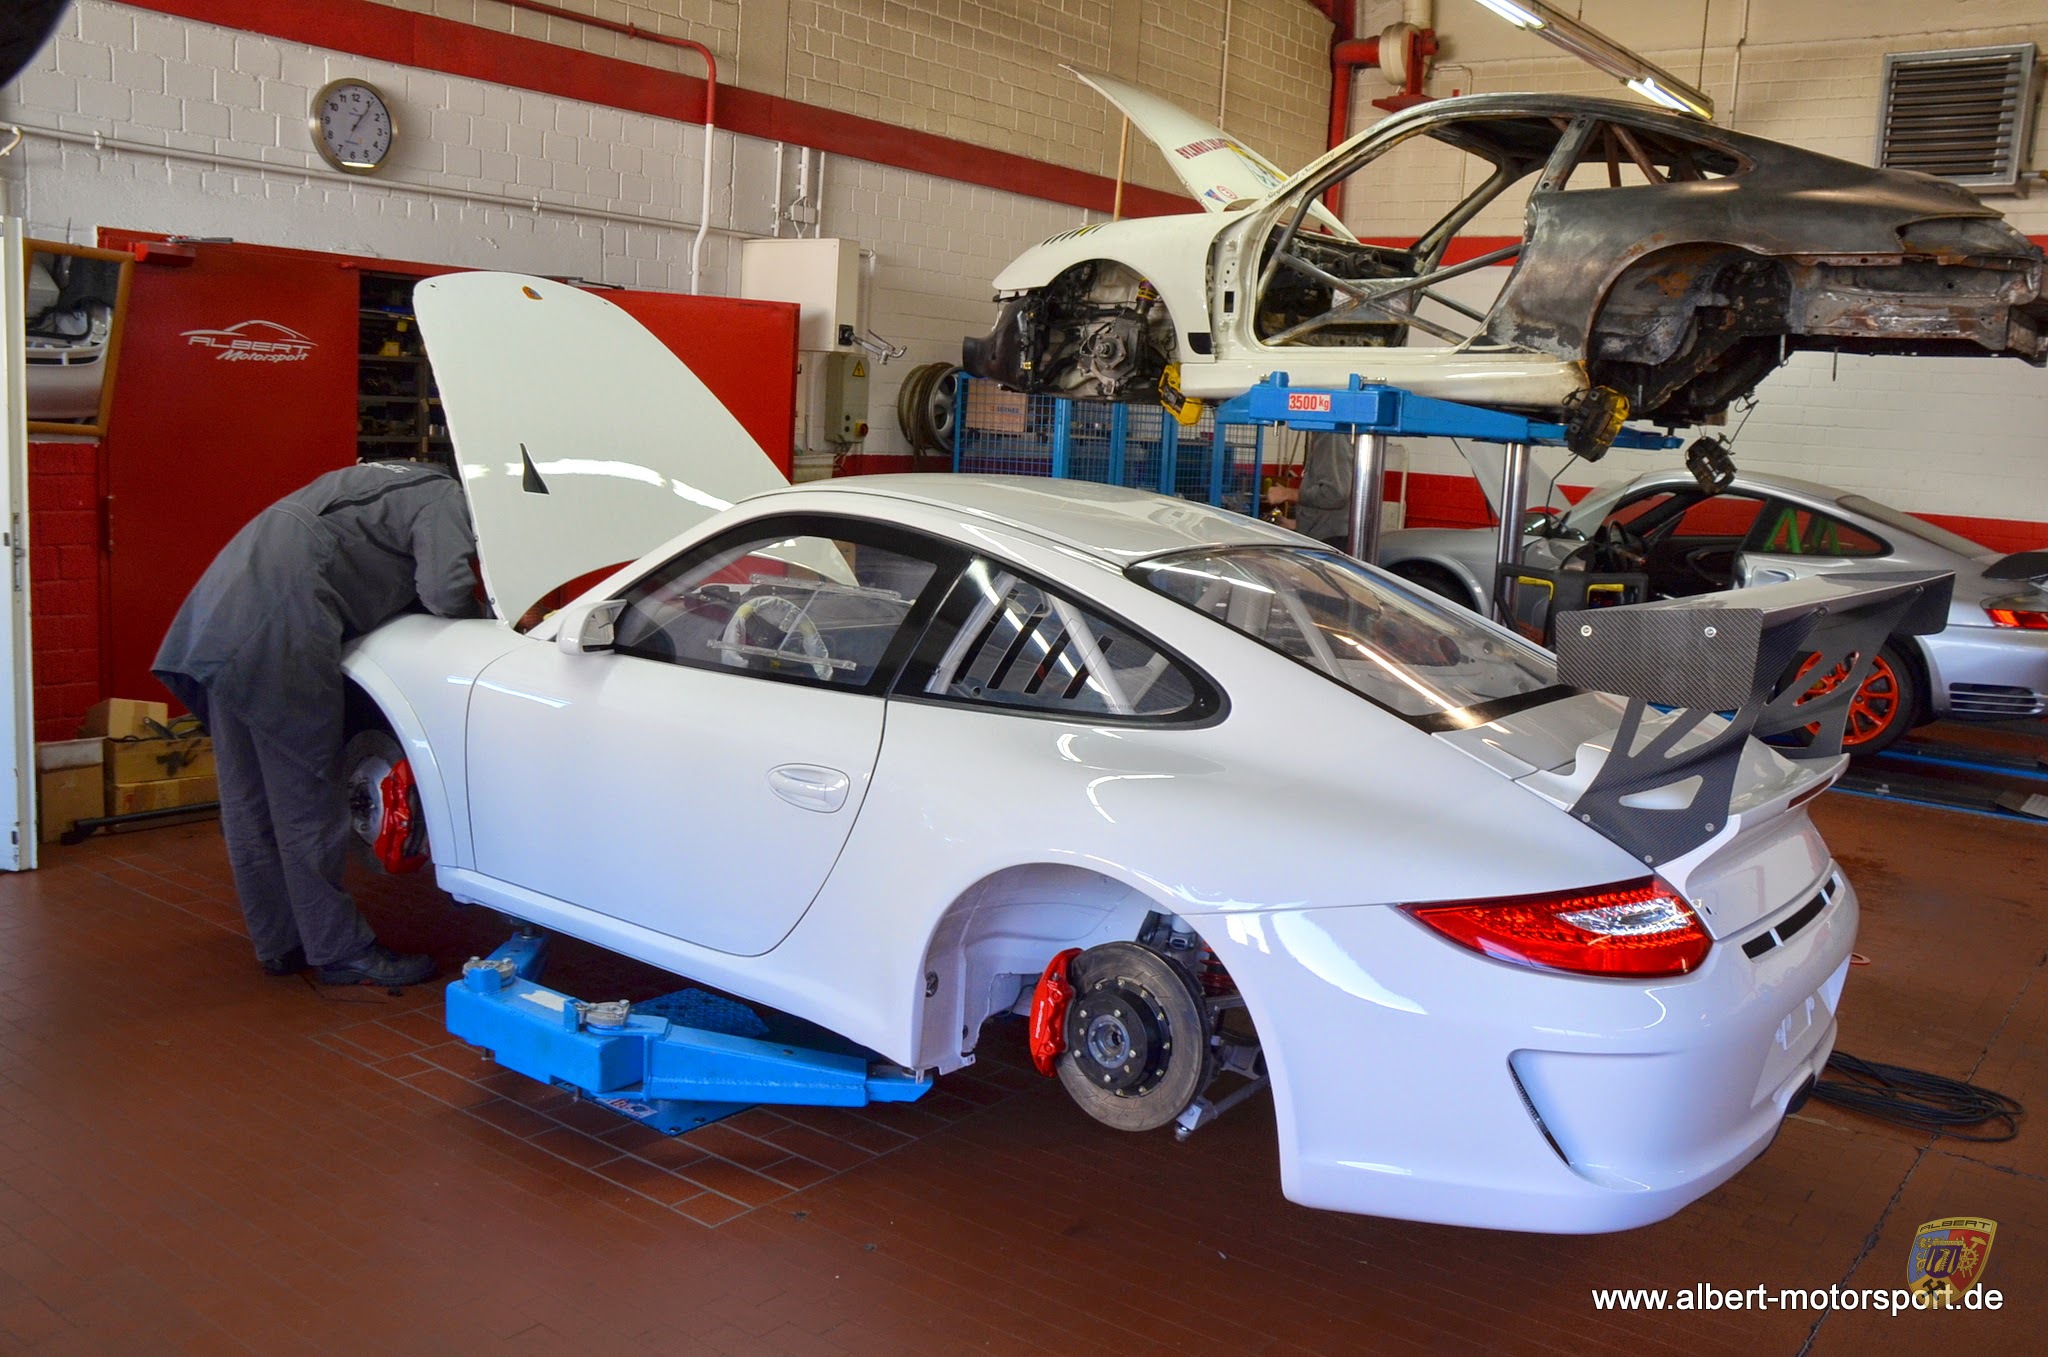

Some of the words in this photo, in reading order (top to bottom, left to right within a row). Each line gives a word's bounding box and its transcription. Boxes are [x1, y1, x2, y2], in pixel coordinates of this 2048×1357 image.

[339, 93, 347, 103] 11
[351, 93, 361, 103] 12
[329, 102, 339, 112] 10
[325, 116, 331, 125] 9
[374, 113, 380, 122] 2
[327, 130, 334, 139] 8
[377, 127, 383, 137] 3
[337, 144, 343, 153] 7
[372, 141, 379, 149] 4
[350, 151, 356, 160] 6
[363, 149, 370, 158] 5
[188, 335, 312, 354] ALBERT
[215, 349, 309, 363] Motorsport
[1289, 395, 1317, 410] 3500
[1319, 395, 1329, 411] kg
